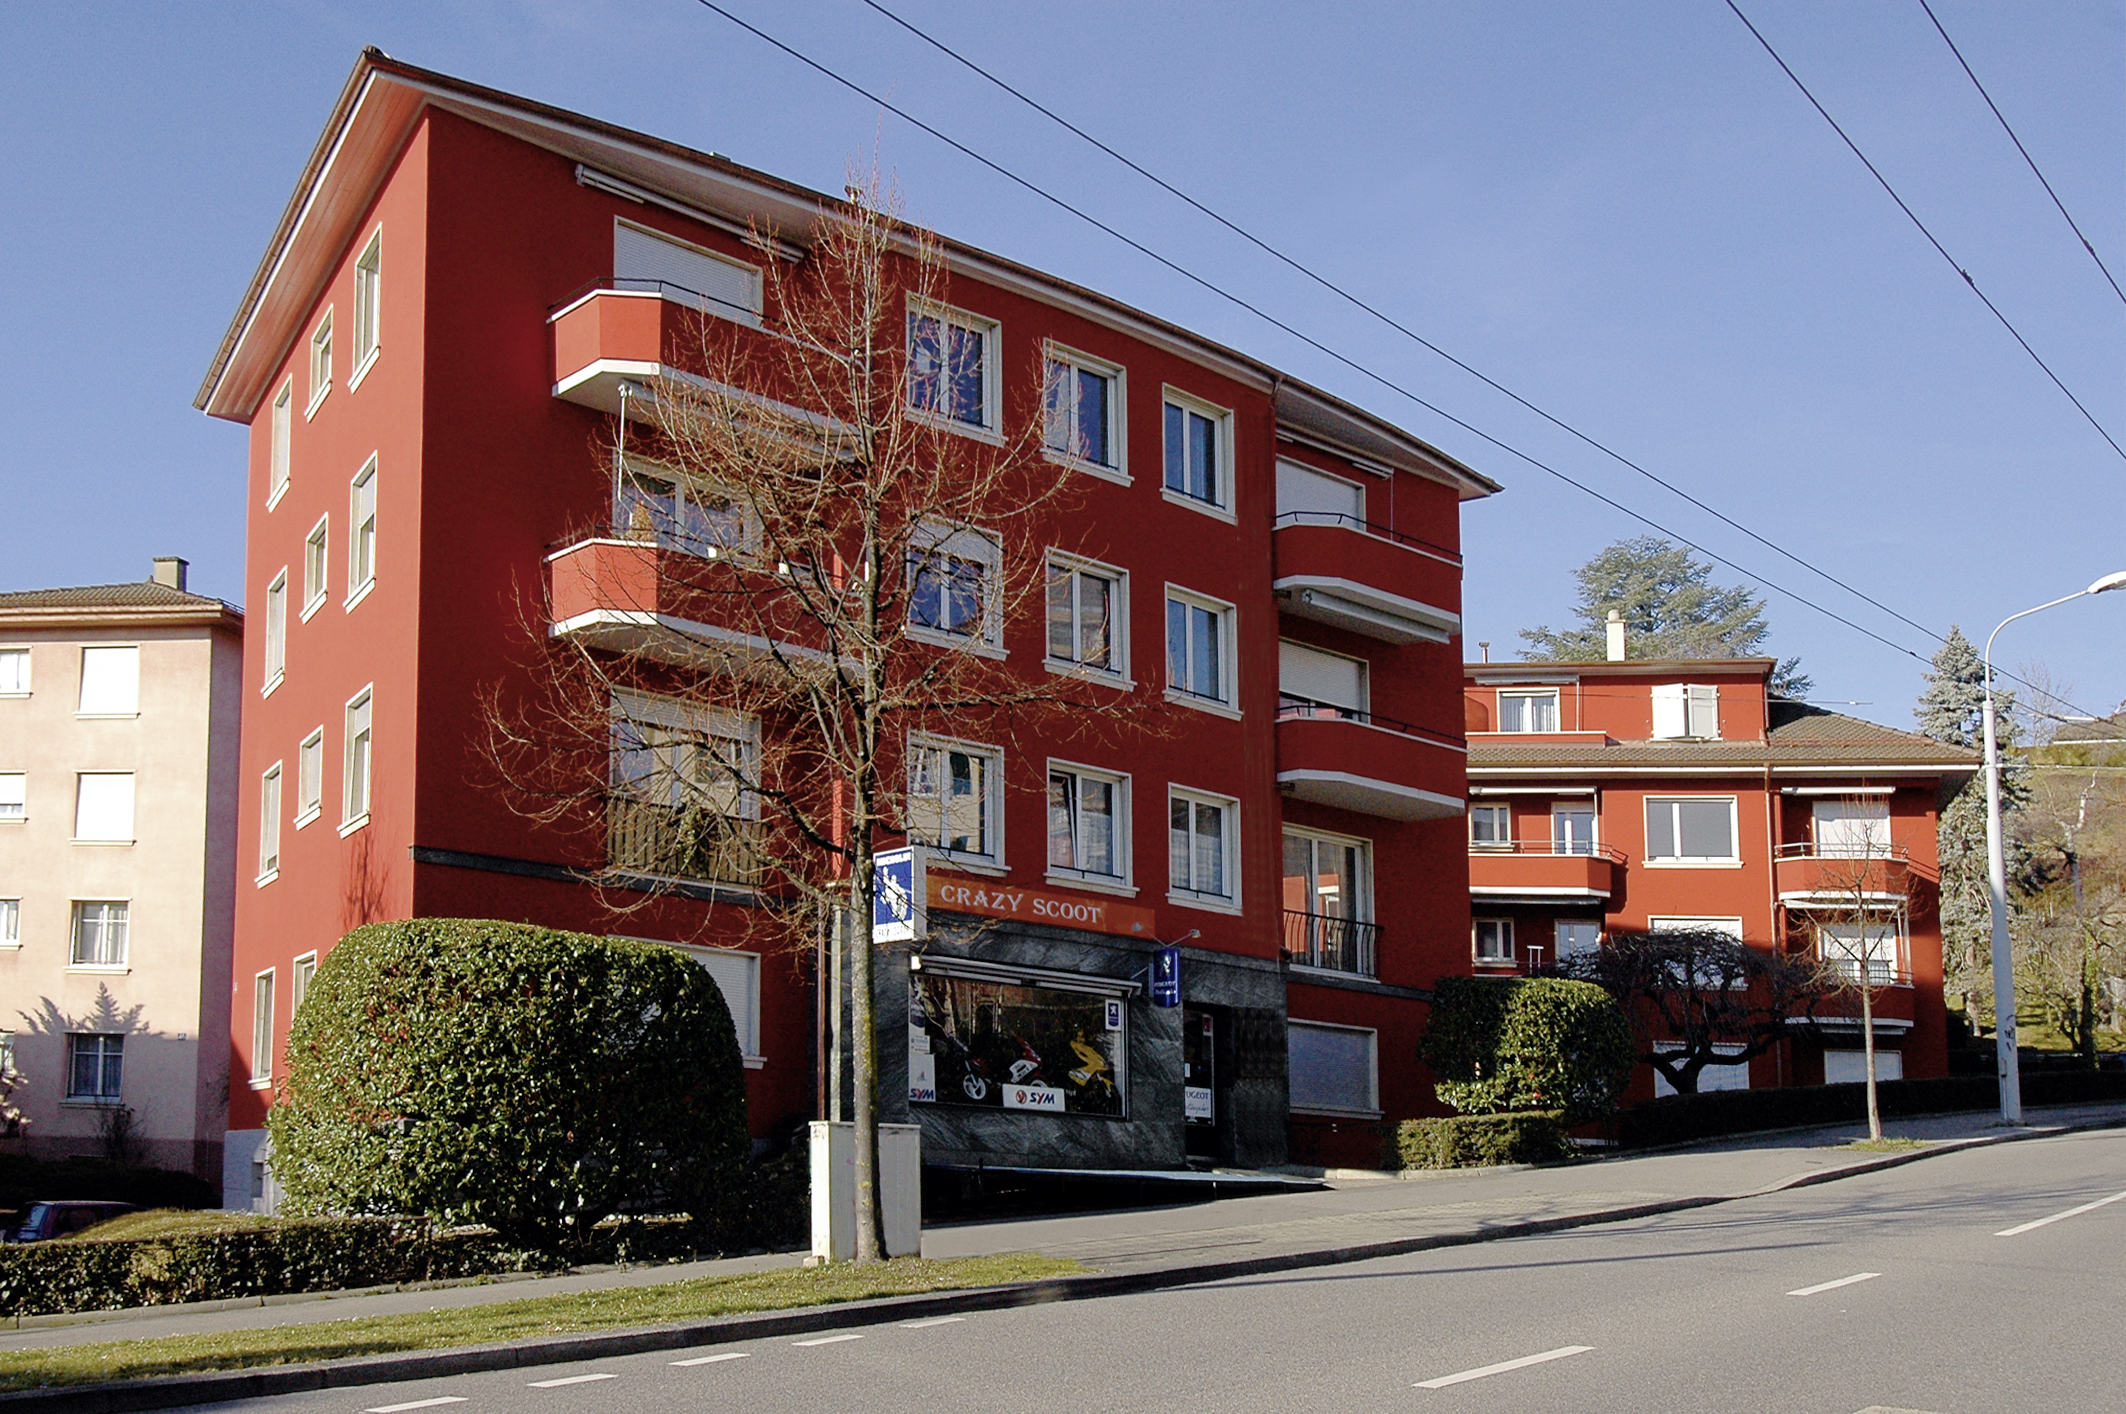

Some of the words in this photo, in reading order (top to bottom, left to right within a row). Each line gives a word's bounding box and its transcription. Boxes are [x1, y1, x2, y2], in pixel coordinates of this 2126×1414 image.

[941, 885, 1024, 912] CRAZY
[1033, 898, 1100, 924] SCOOT
[909, 1088, 934, 1100] SYM
[1029, 1092, 1055, 1104] SYM
